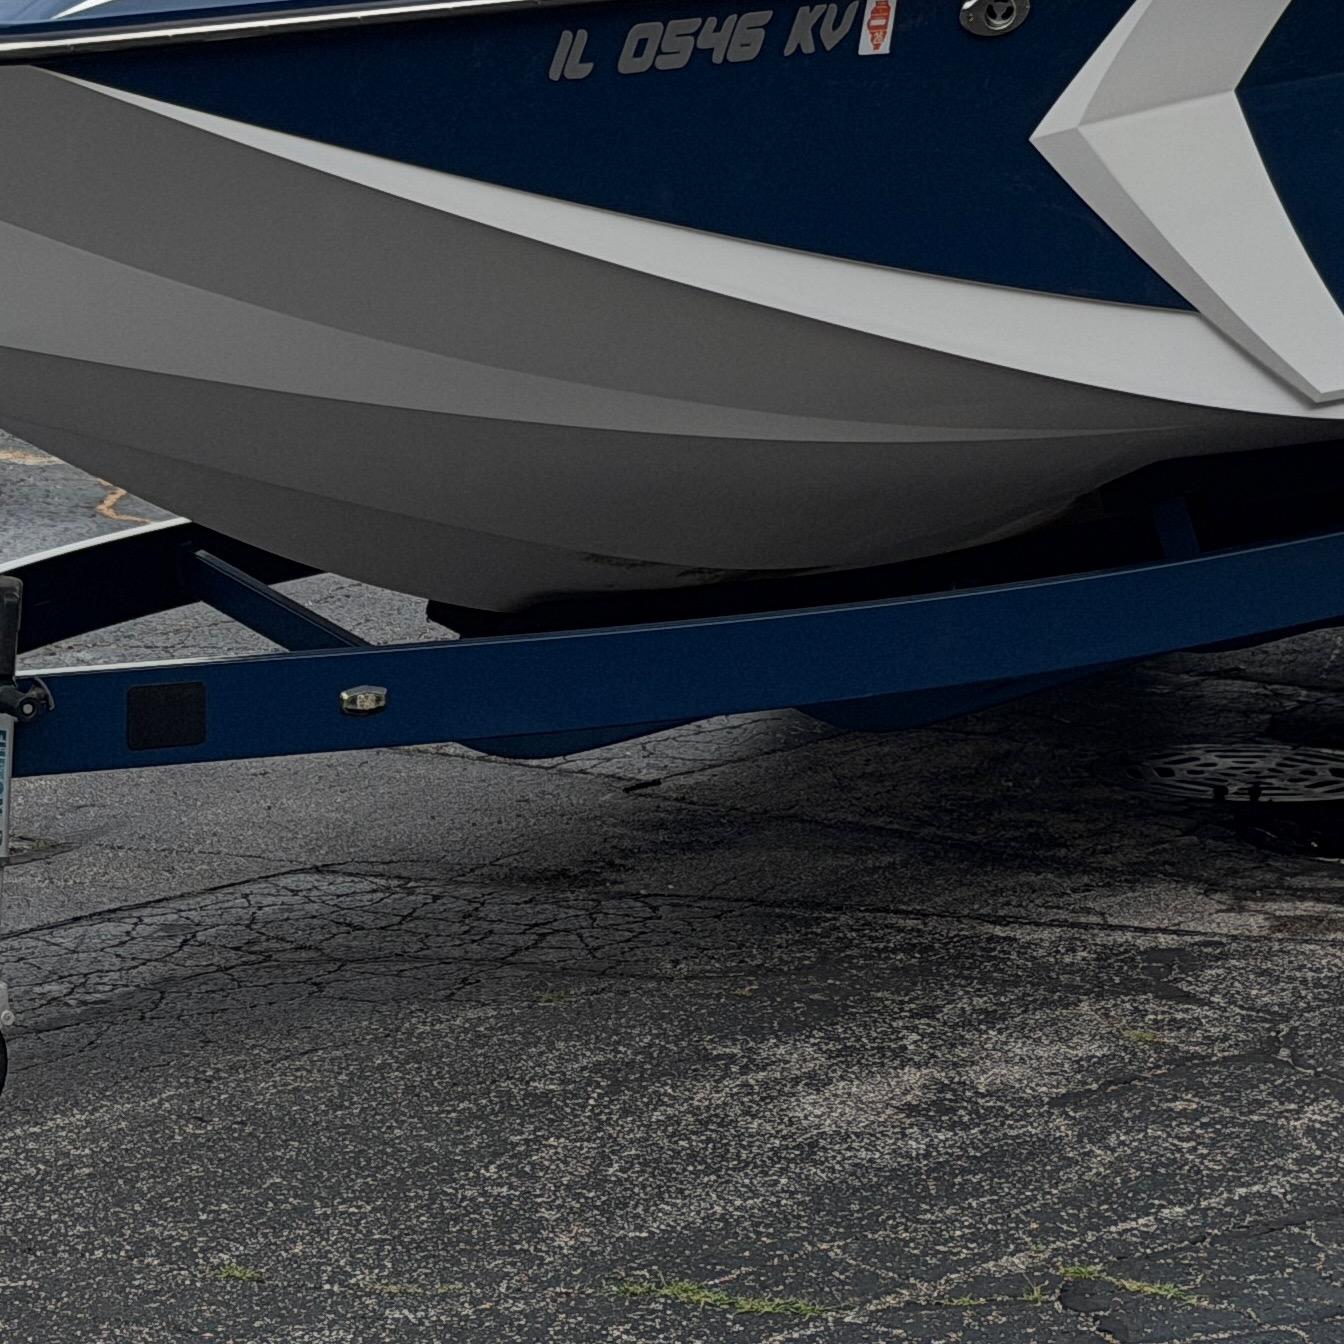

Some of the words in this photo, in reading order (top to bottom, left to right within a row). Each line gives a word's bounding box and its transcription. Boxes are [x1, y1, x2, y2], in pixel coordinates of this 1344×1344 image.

[549, 30, 593, 81] IL
[617, 10, 773, 74] 0546
[784, 1, 859, 56] KV
